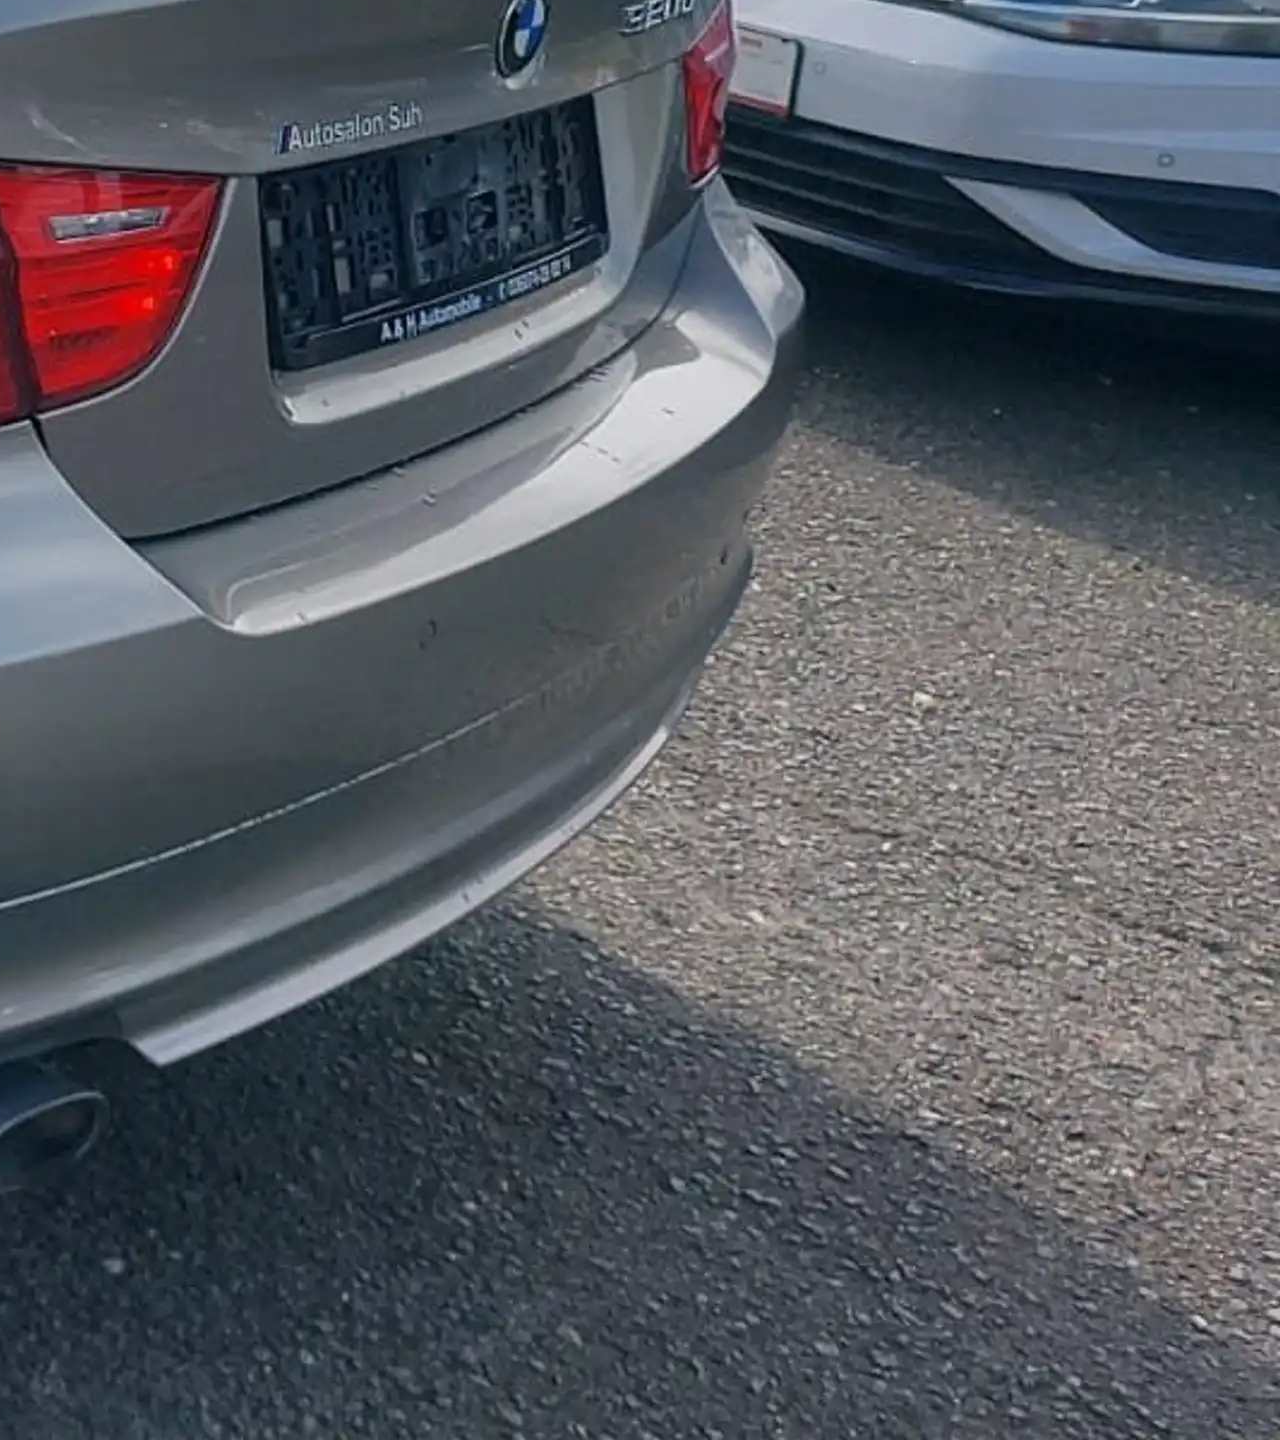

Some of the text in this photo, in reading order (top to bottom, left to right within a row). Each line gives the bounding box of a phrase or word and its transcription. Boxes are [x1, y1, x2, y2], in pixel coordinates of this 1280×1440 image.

[288, 113, 385, 151] Autosalon
[381, 322, 393, 343] A
[394, 318, 405, 341] &
[419, 293, 482, 329] Automobile
